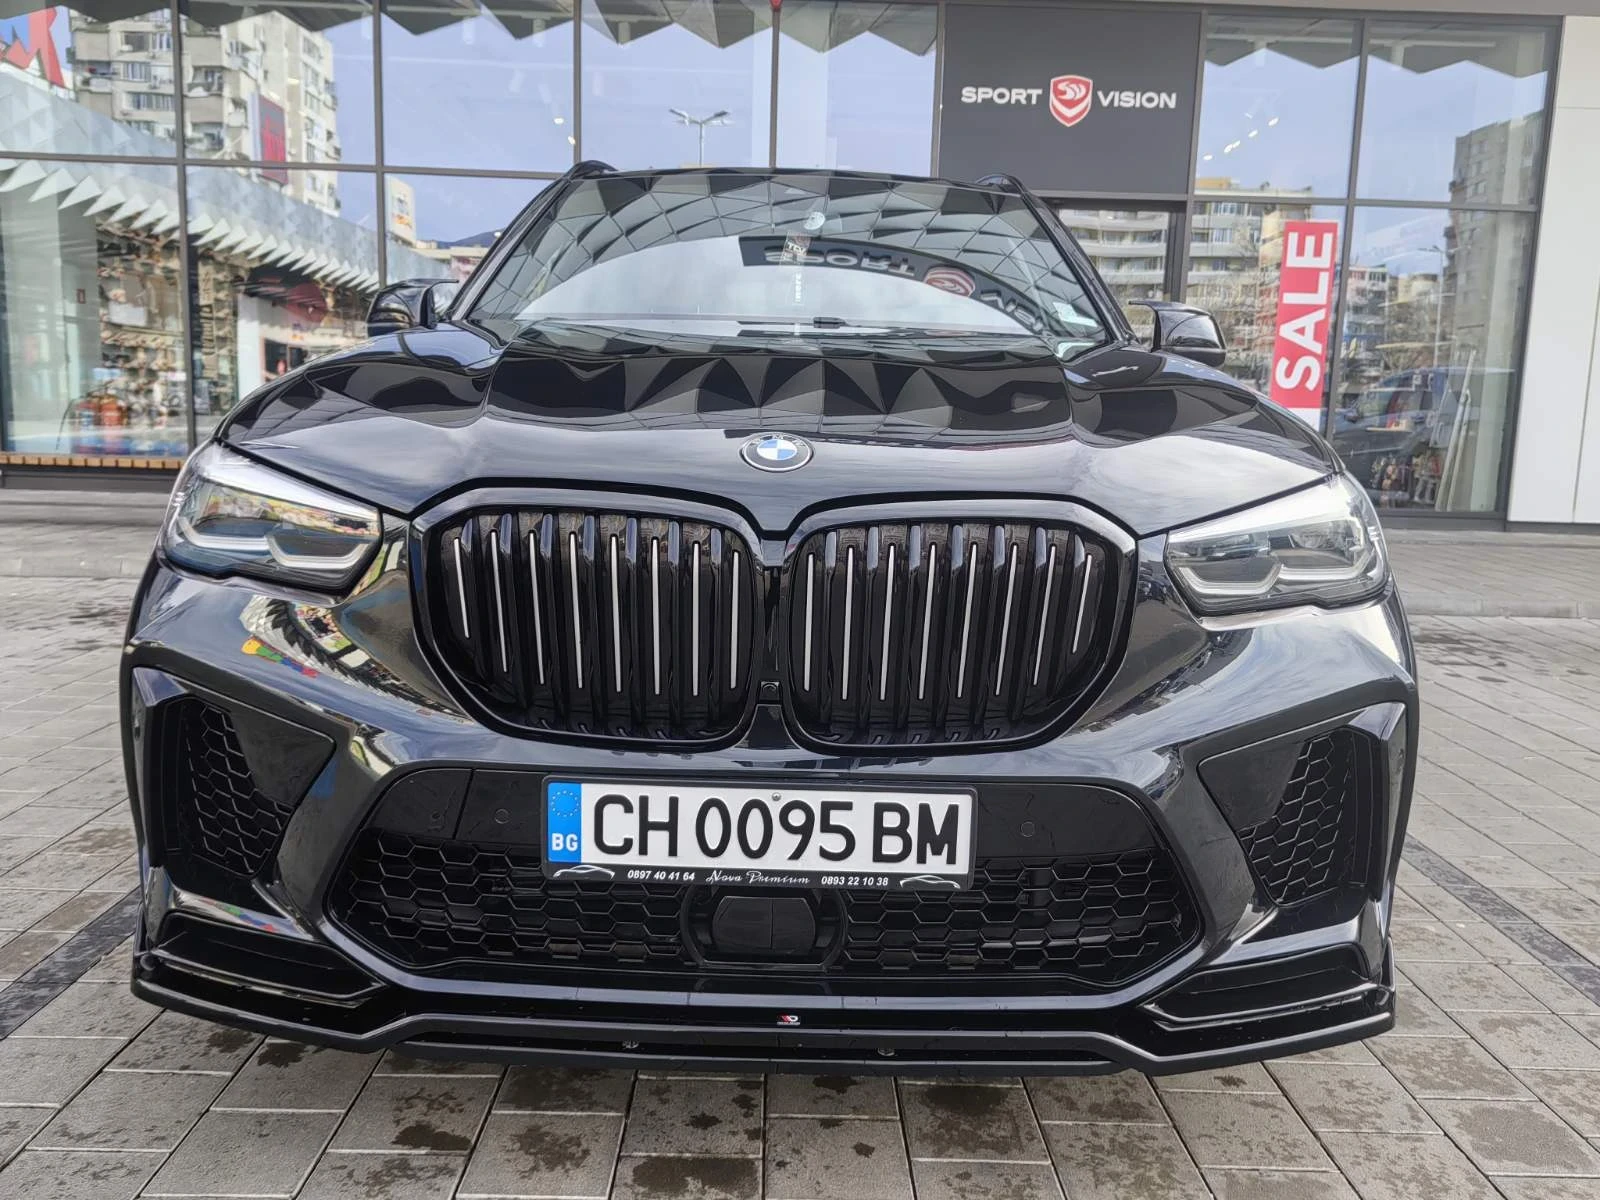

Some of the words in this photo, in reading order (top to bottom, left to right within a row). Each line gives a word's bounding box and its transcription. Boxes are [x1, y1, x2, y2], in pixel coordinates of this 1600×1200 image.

[961, 86, 1042, 105] SPORT
[1097, 90, 1177, 109] VISION
[1275, 232, 1334, 391] SALE
[594, 794, 679, 857] CH
[695, 797, 856, 862] 0095
[872, 802, 959, 865] BM
[551, 833, 579, 852] BG
[627, 869, 652, 880] 0897
[653, 870, 669, 881] 40
[670, 871, 681, 881] 41
[683, 871, 695, 882] 64
[706, 870, 743, 883] Nova
[746, 870, 810, 884] Premium
[821, 875, 845, 886] 0893
[847, 876, 860, 886] 22
[862, 876, 875, 886] 10
[876, 876, 889, 887] 38
